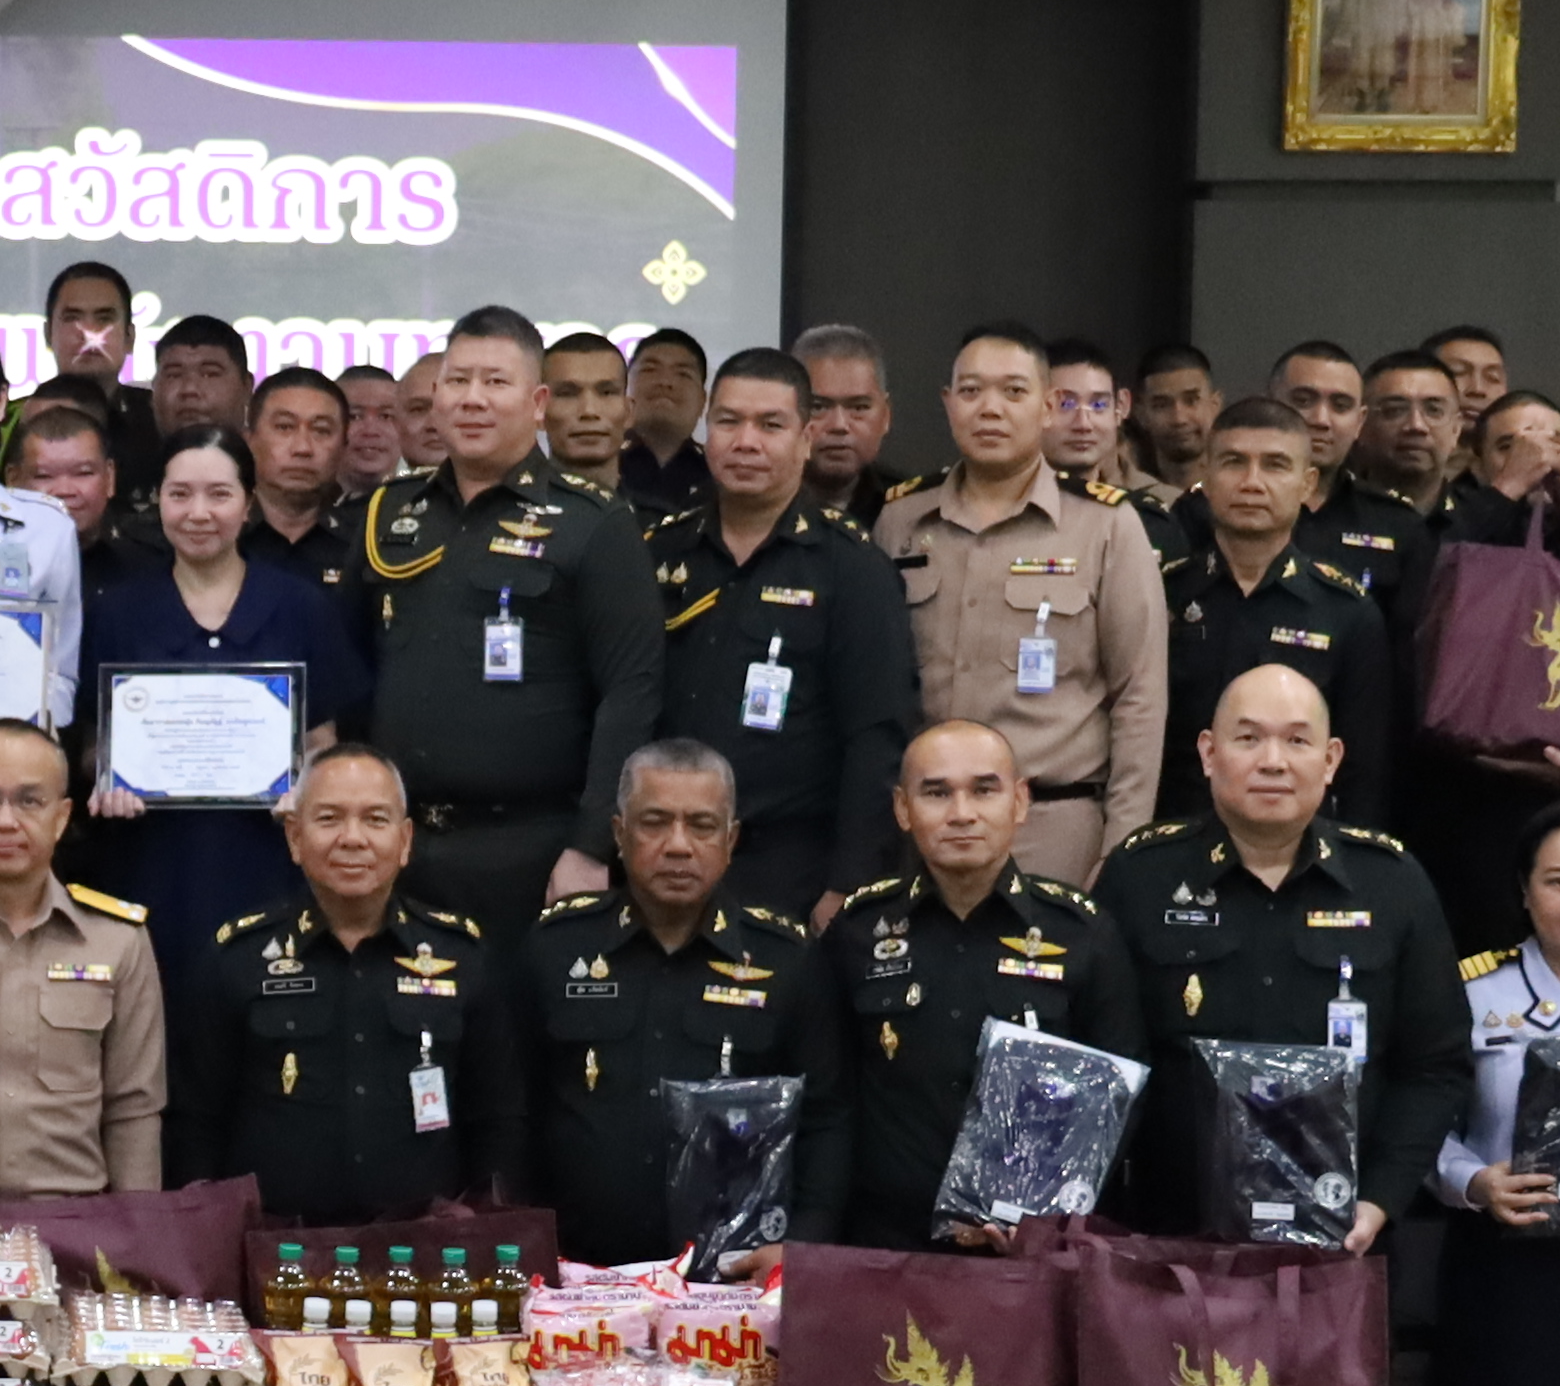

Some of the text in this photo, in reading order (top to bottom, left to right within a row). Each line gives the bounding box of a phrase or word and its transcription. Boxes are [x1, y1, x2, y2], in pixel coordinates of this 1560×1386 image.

[5, 1267, 12, 1278] 2
[0, 1326, 7, 1337] 2
[216, 1338, 224, 1350] 2
[666, 1314, 763, 1368] มาม่า
